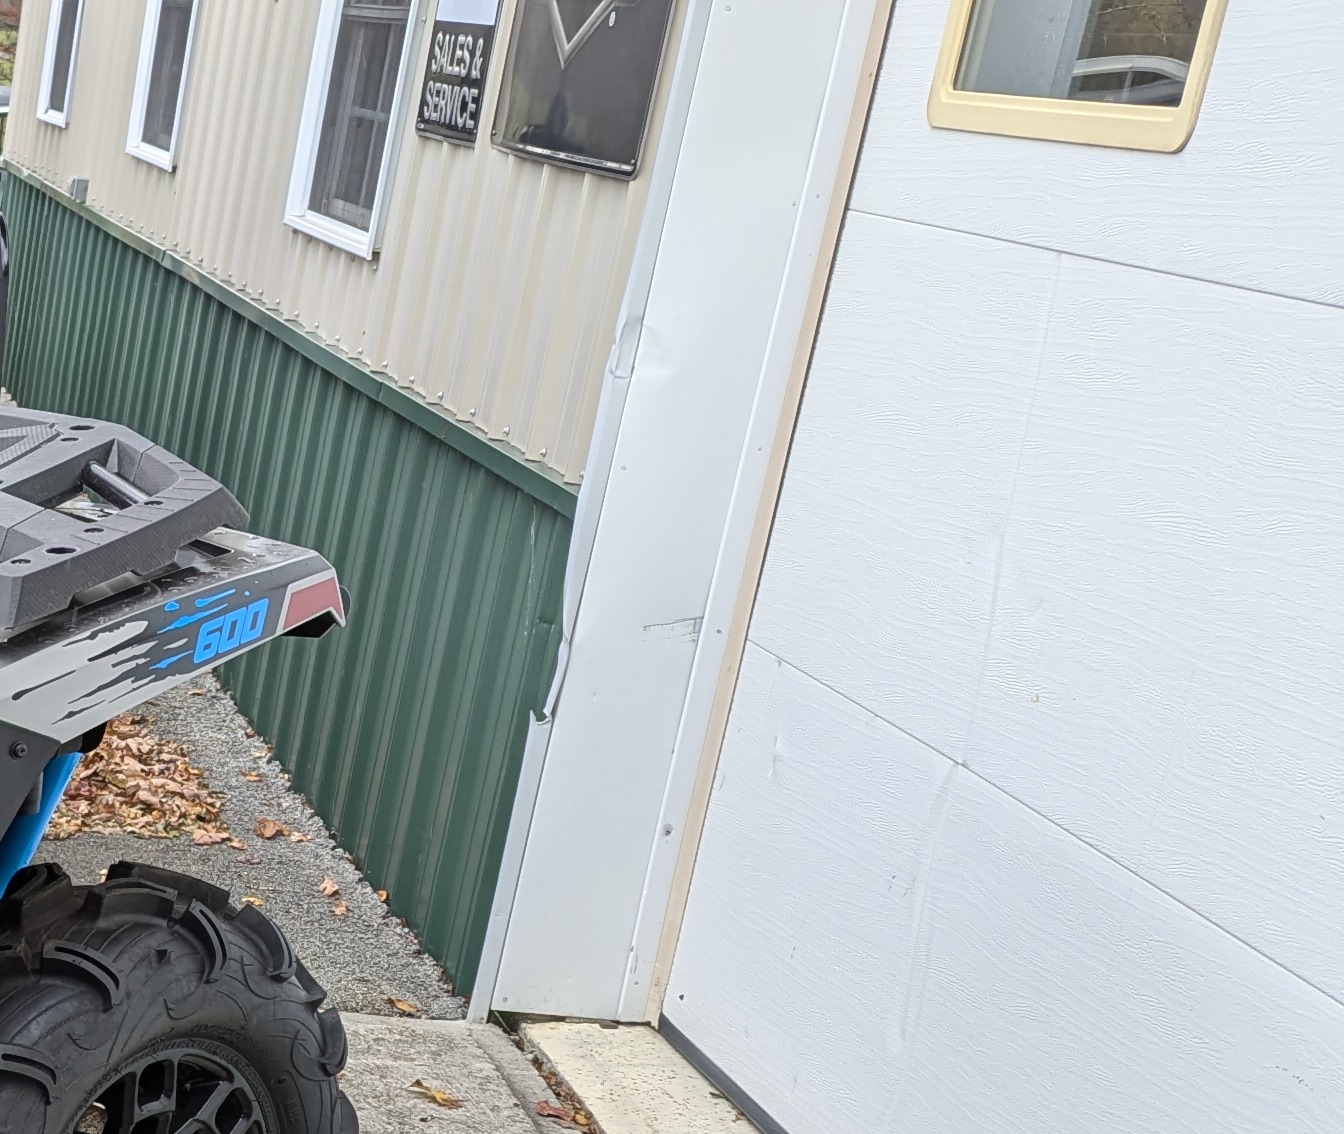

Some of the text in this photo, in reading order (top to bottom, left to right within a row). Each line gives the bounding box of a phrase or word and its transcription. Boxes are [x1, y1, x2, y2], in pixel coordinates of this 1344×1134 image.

[431, 31, 484, 79] SALES &
[423, 80, 479, 130] SERVICE
[193, 598, 269, 663] 600
